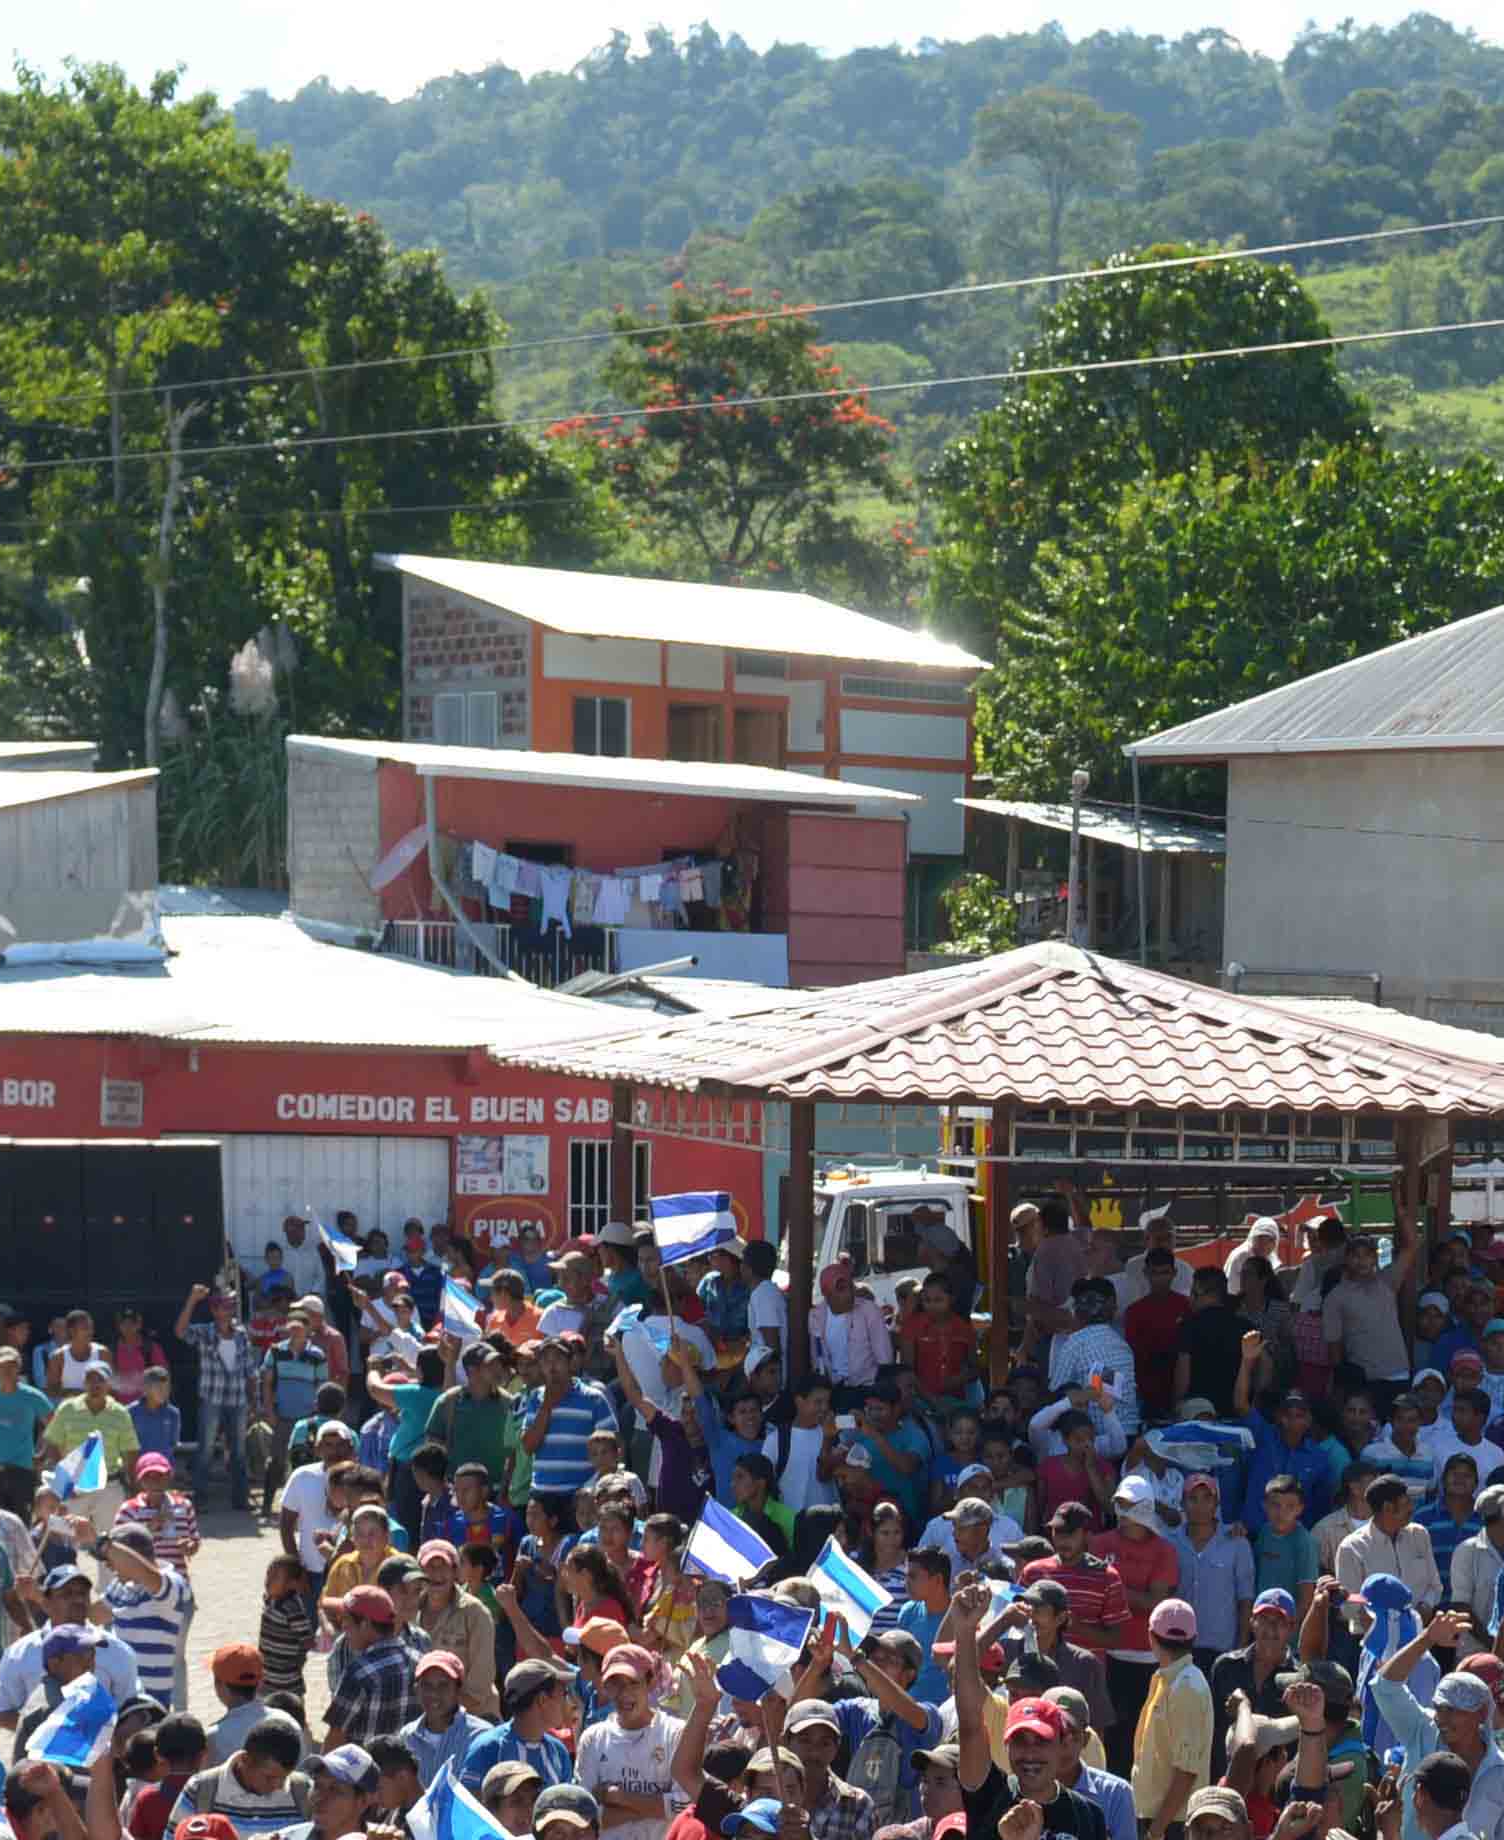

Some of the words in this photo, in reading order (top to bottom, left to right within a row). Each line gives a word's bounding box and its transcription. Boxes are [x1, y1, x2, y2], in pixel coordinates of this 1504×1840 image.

[277, 1093, 416, 1122] COMEDOR
[425, 1096, 459, 1122] EL
[471, 1096, 544, 1123] BUEN
[553, 1098, 649, 1124] SABR
